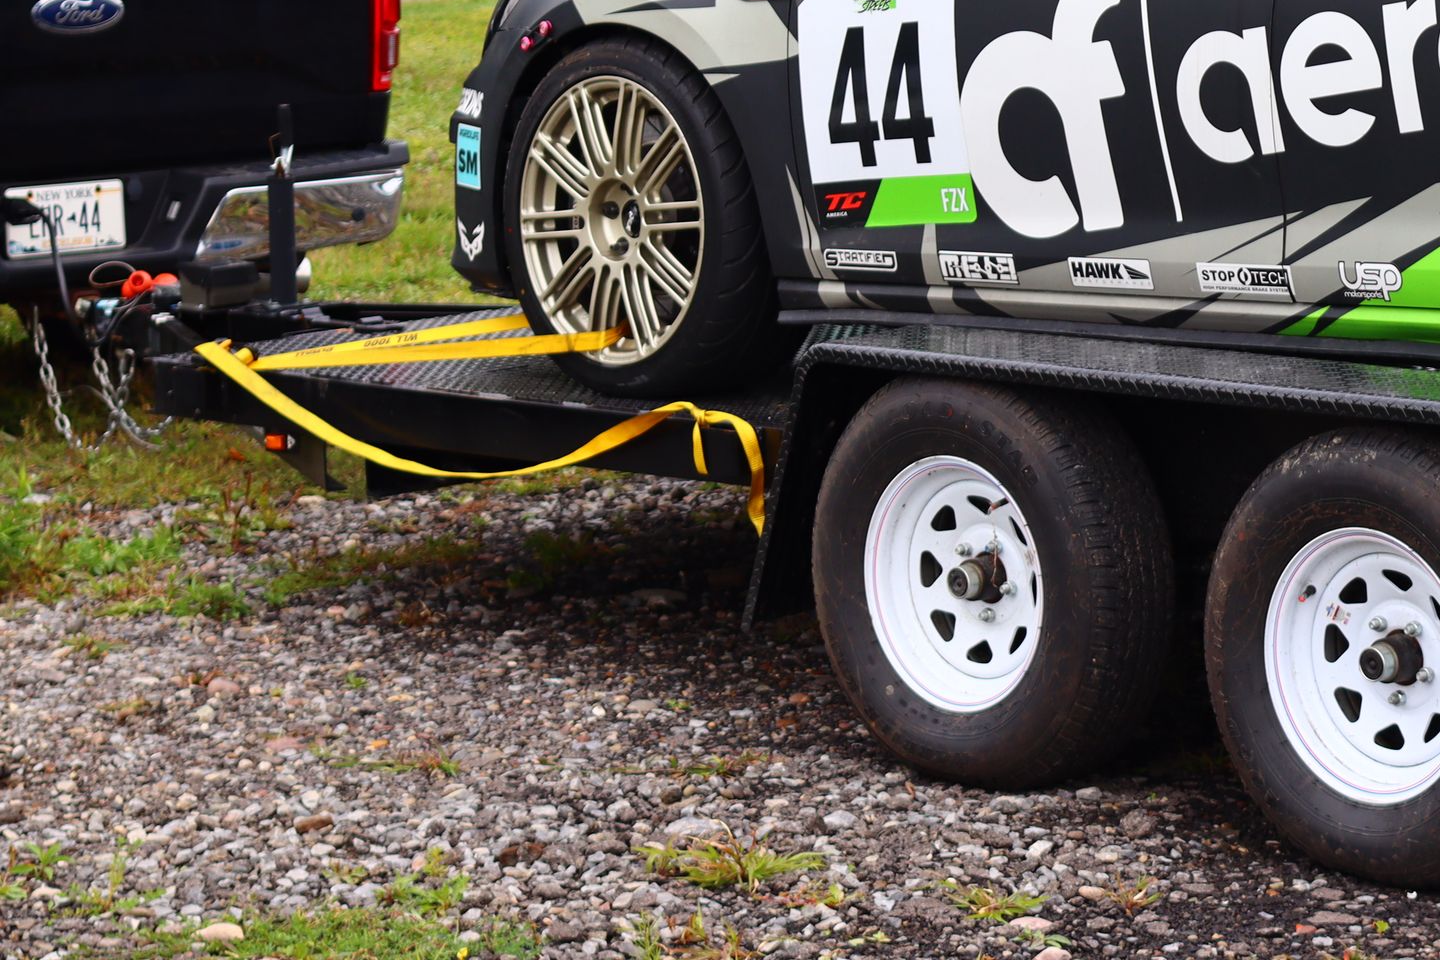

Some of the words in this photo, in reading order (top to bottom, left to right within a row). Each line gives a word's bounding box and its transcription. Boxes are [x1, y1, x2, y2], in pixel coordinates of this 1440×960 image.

[56, 0, 105, 23] Ford
[828, 21, 935, 167] 44
[458, 148, 478, 176] SM
[36, 191, 61, 202] NEW
[65, 188, 94, 200] YORK
[941, 187, 970, 212] FZX
[79, 200, 101, 234] 44
[1071, 261, 1123, 280] HAWK
[1338, 261, 1402, 301] USP
[1344, 290, 1384, 299] motorsports
